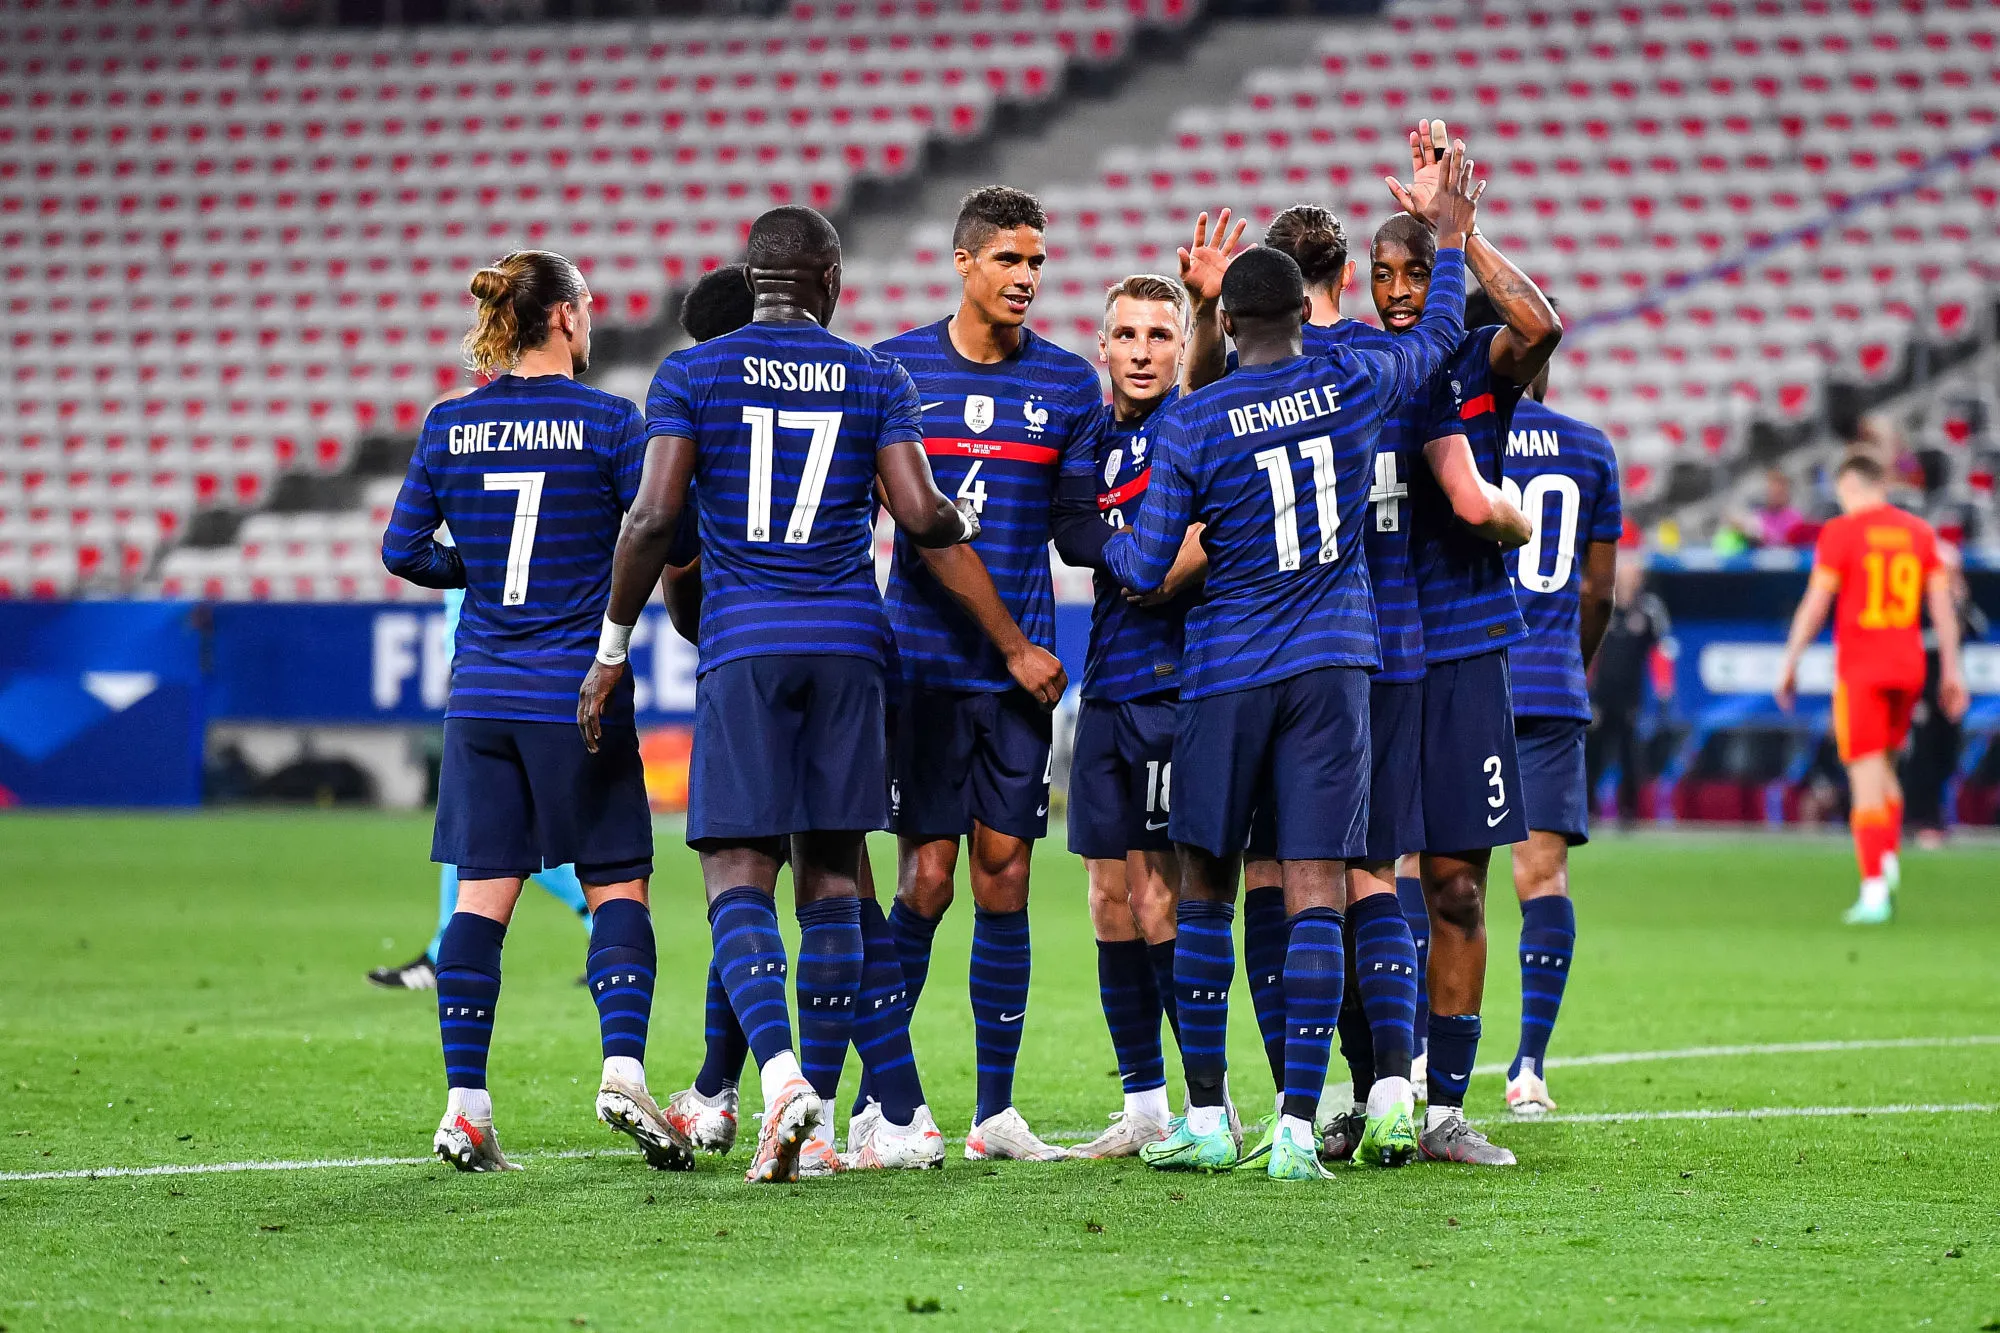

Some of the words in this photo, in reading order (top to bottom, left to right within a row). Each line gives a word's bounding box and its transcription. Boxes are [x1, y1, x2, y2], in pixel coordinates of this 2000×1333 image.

[743, 356, 846, 392] SISSOKO
[1227, 384, 1341, 437] DEMBELE
[449, 420, 584, 455] GRIEZMANN
[1506, 430, 1560, 457] MAN
[742, 405, 844, 544] 17
[957, 460, 988, 514] 4
[1254, 435, 1341, 572] 11
[483, 472, 546, 606] 7
[1858, 552, 1922, 629] 19
[1483, 755, 1506, 808] 3
